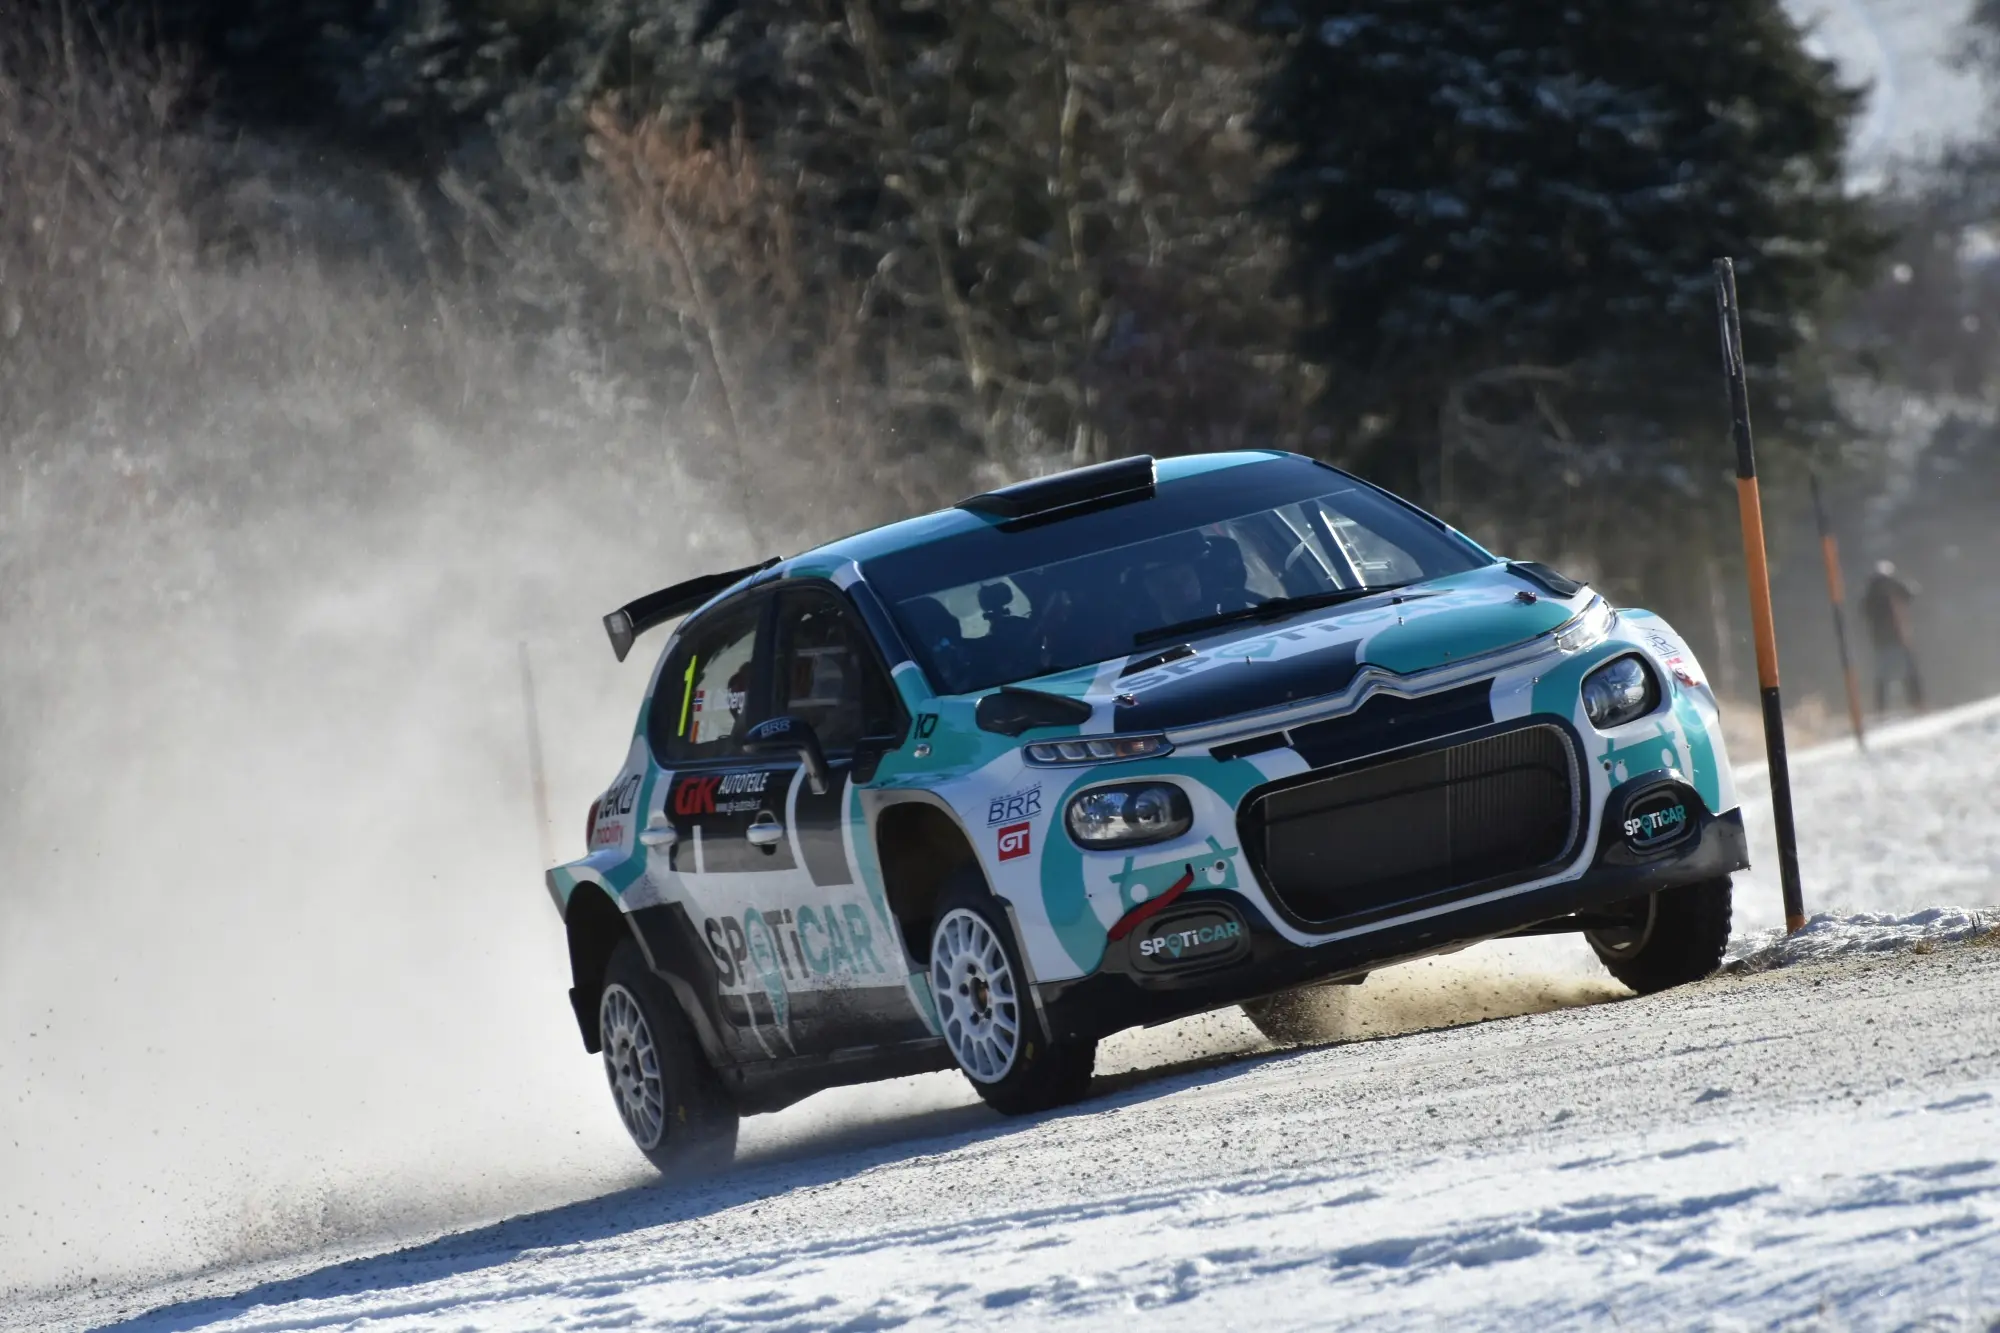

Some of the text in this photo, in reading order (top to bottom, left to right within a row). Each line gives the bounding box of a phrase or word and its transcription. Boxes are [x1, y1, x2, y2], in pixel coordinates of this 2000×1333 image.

[675, 776, 721, 815] GK
[717, 772, 770, 795] AUTOTEILE
[988, 790, 1041, 822] BRR
[1000, 829, 1028, 852] GT
